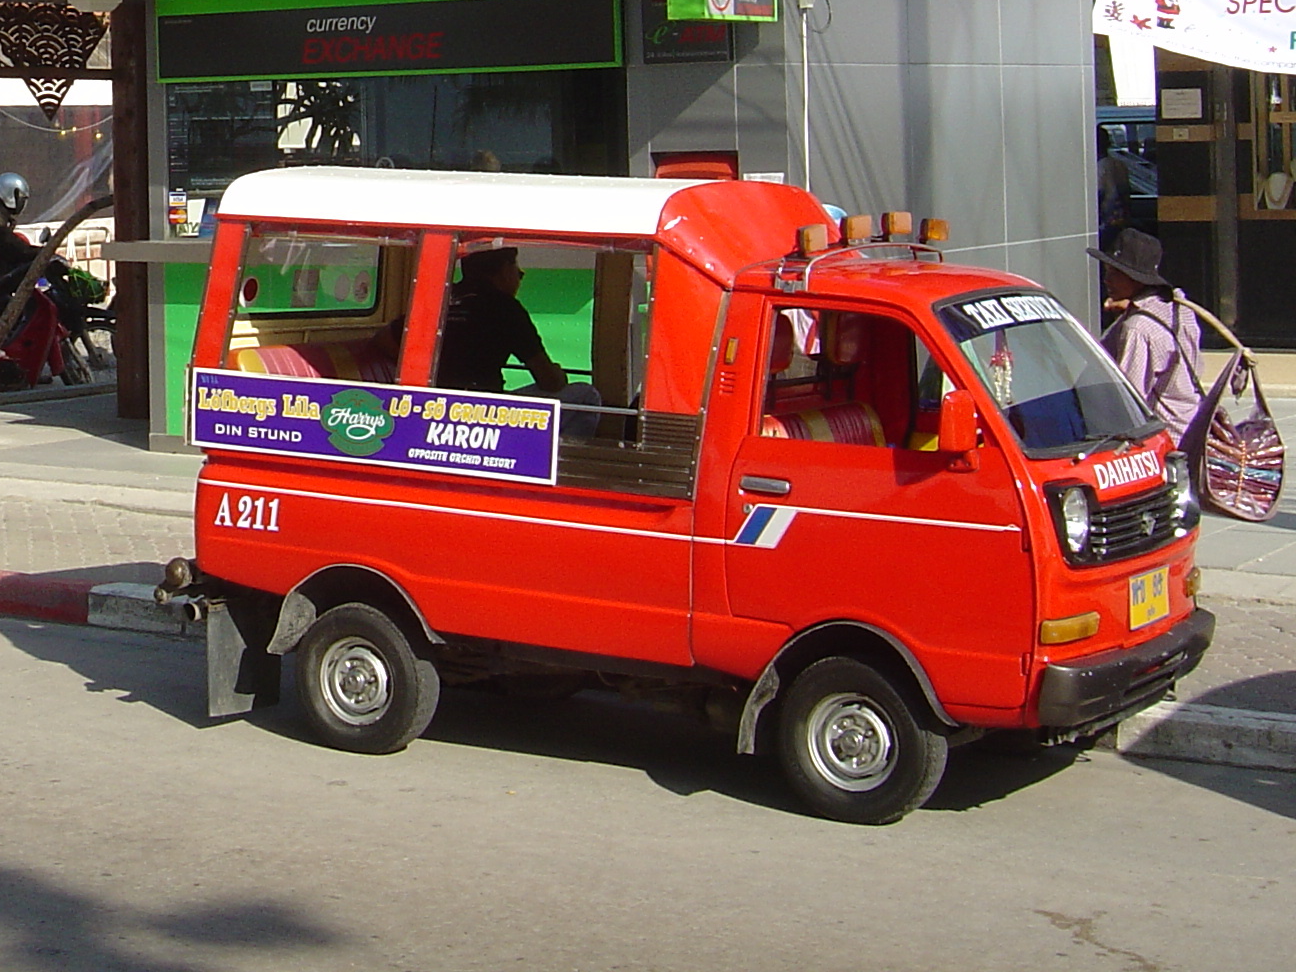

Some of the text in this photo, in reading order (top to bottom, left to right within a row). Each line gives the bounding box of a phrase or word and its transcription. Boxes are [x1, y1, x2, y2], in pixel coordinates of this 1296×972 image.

[306, 16, 377, 34] currency
[301, 31, 445, 65] EXCHANGE
[962, 298, 1016, 330] TAXI
[198, 386, 321, 421] Löfbergs Lila
[327, 407, 386, 428] Harrys
[214, 423, 302, 443] DIN STUND
[426, 421, 501, 450] KARON
[408, 448, 517, 469] OPPOSITE ORCHID RESORT
[1093, 450, 1161, 490] DAIHATSU
[214, 492, 280, 532] A 211
